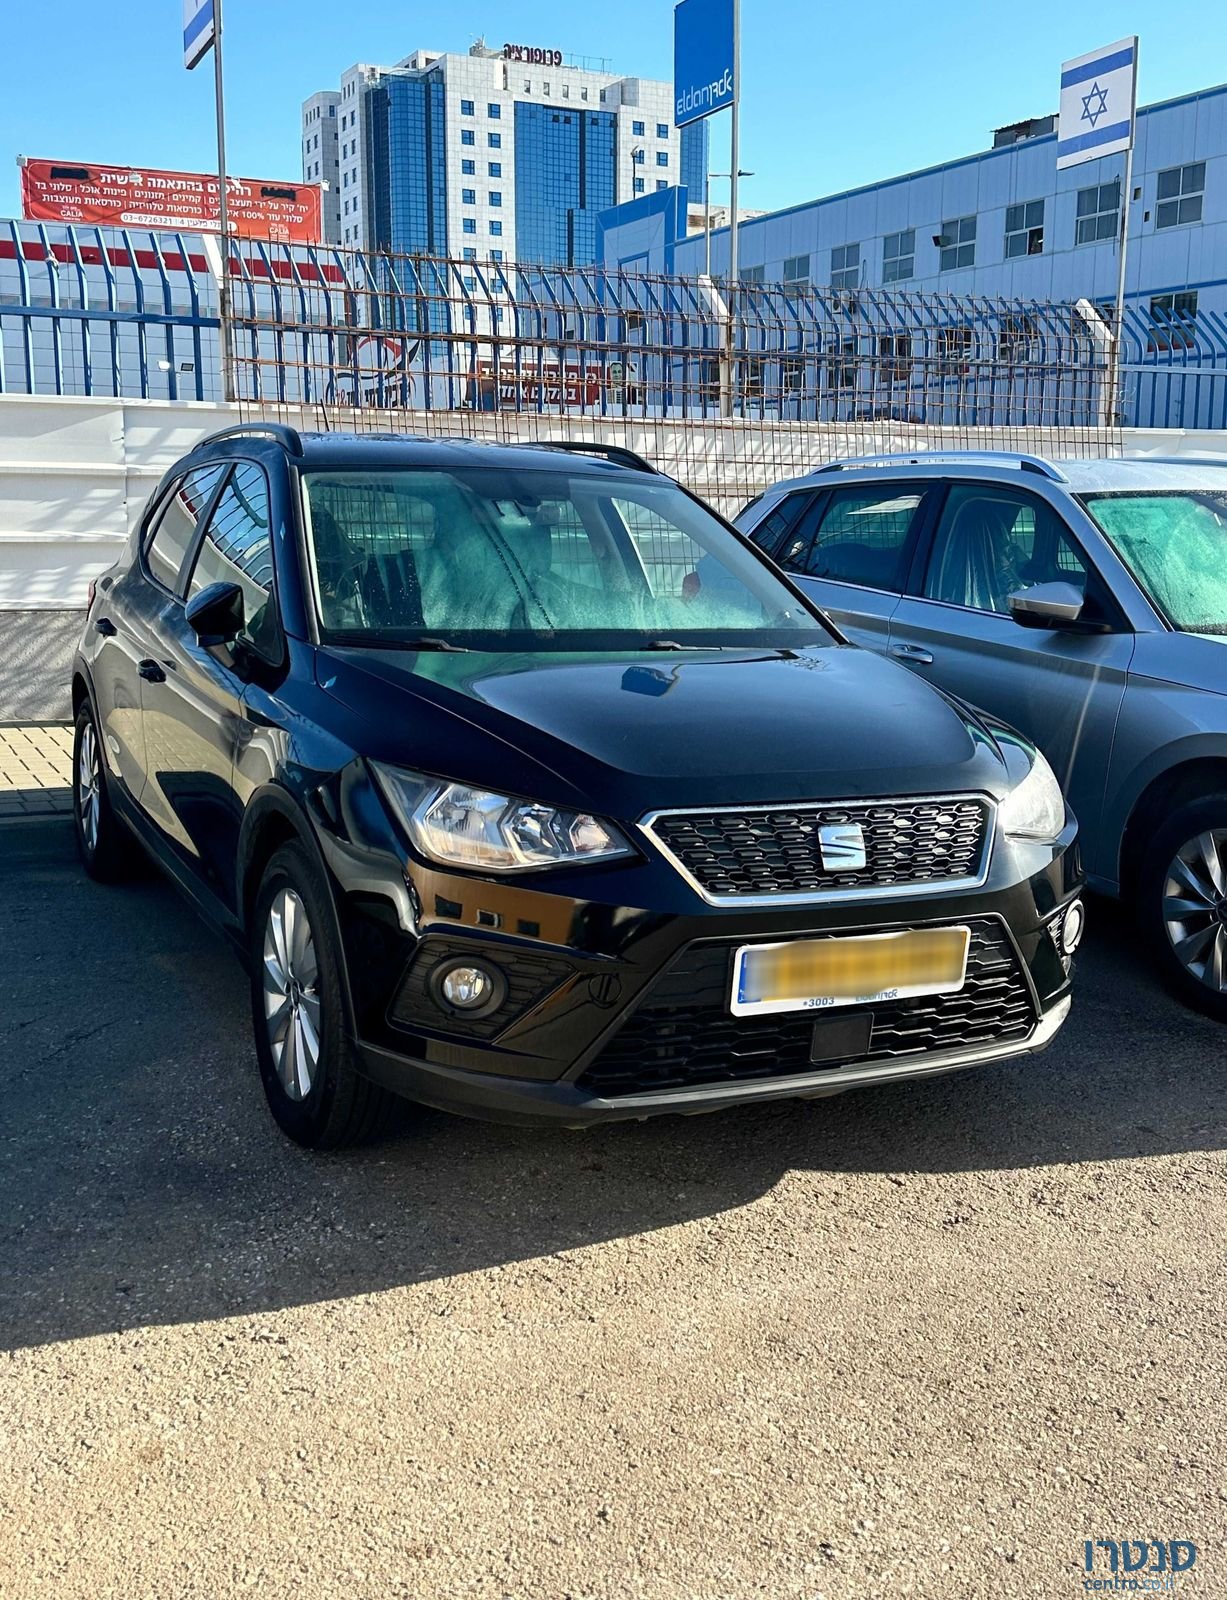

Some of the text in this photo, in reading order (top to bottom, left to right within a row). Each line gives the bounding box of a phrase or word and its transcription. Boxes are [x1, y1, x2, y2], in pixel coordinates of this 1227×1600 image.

[677, 86, 709, 115] eldan
[100, 173, 143, 187] אשית
[147, 178, 204, 192] בהתאמה
[35, 181, 47, 190] בד
[49, 182, 72, 192] סלוני
[80, 184, 101, 194] אוכל
[103, 187, 127, 197] פינות
[134, 190, 165, 200] מזנונים
[42, 194, 82, 204] מעוצבות
[84, 197, 122, 207] כורסאות
[172, 193, 202, 204] קמינים
[166, 204, 202, 214] כורסאות
[267, 201, 279, 210] על
[281, 204, 295, 213] קיר
[60, 209, 84, 218] CALIA
[242, 211, 265, 220] 100%
[267, 212, 281, 221] עור
[283, 213, 303, 223] סלוני
[123, 213, 172, 225] 03-6726321
[269, 227, 289, 235] CALIA
